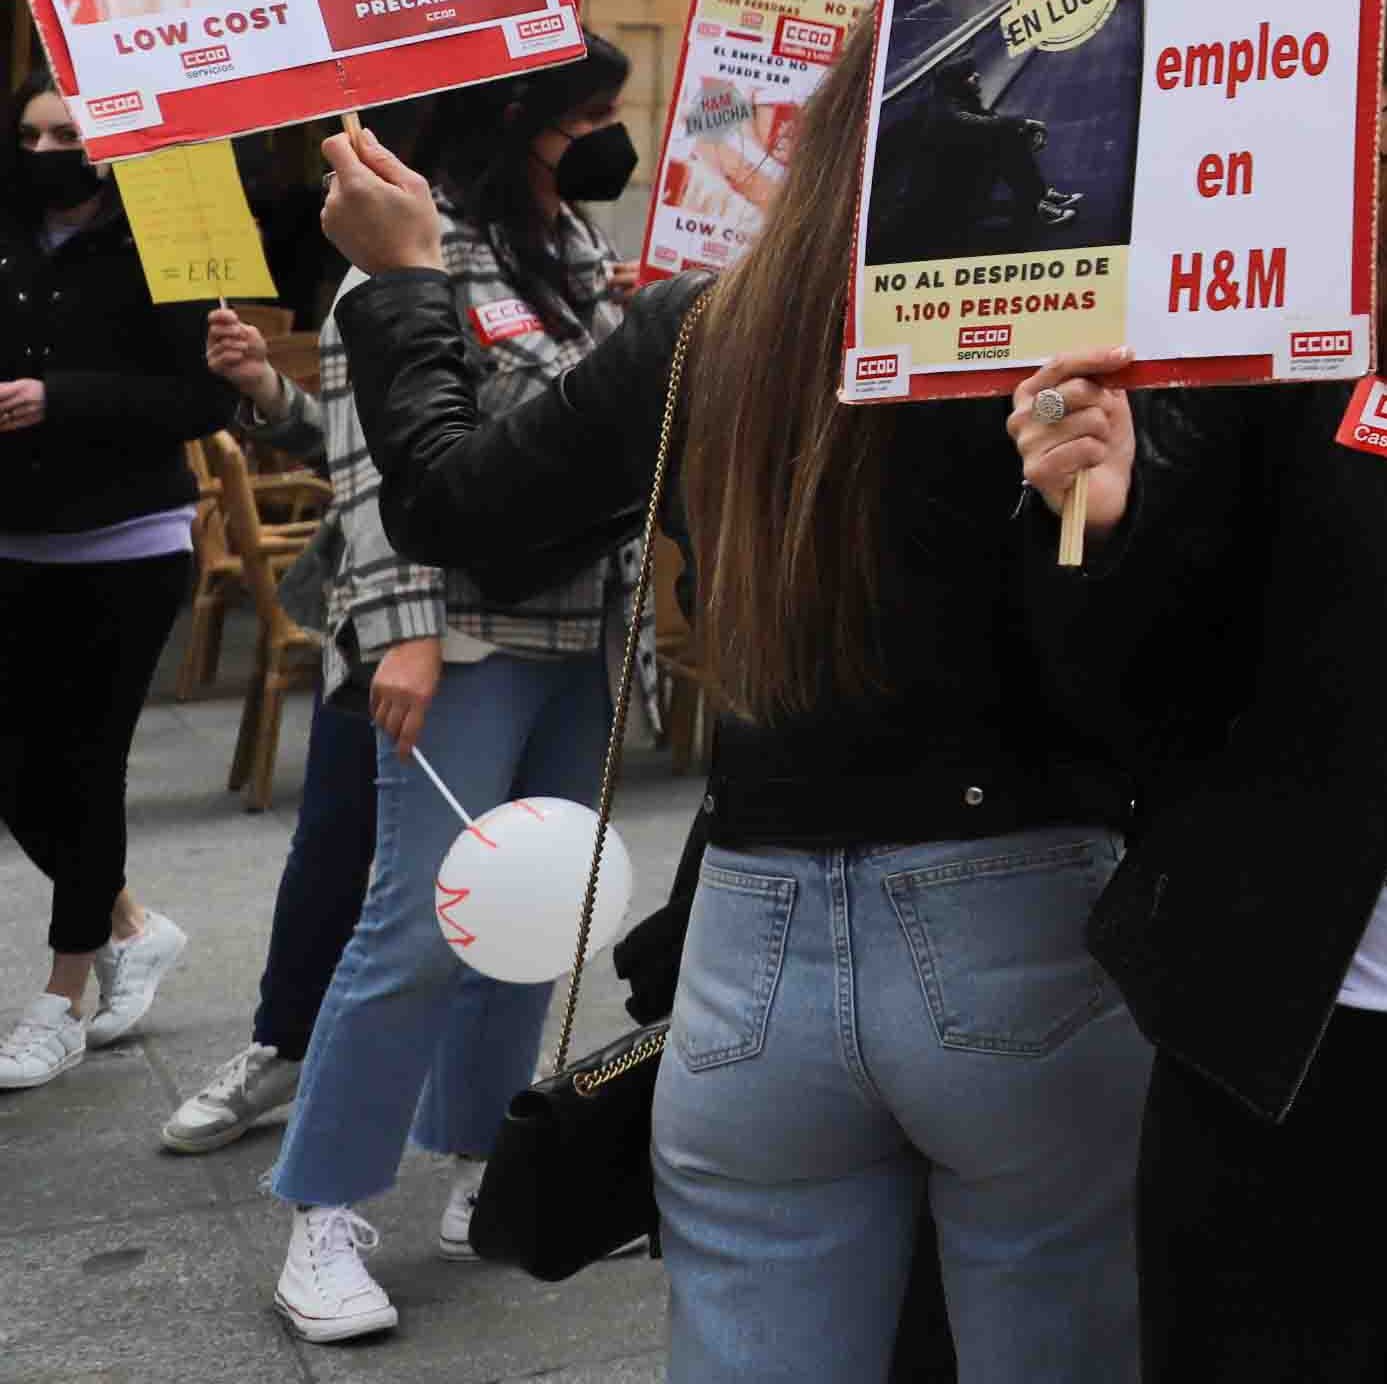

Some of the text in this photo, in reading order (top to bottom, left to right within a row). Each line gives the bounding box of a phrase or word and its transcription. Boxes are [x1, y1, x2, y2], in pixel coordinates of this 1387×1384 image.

[113, 3, 289, 56] LOW COST
[1008, 11, 1043, 47] EN
[184, 62, 236, 79] servicios
[1156, 21, 1330, 99] empleo
[1196, 149, 1253, 198] en
[875, 258, 1109, 292] NO AL DESPIDO DE
[1167, 246, 1288, 313] H&M
[895, 291, 1096, 322] 1.100 PERSONAS
[957, 347, 1010, 360] servicios
[960, 328, 1010, 345] CCOO
[1293, 335, 1350, 354] CCOO
